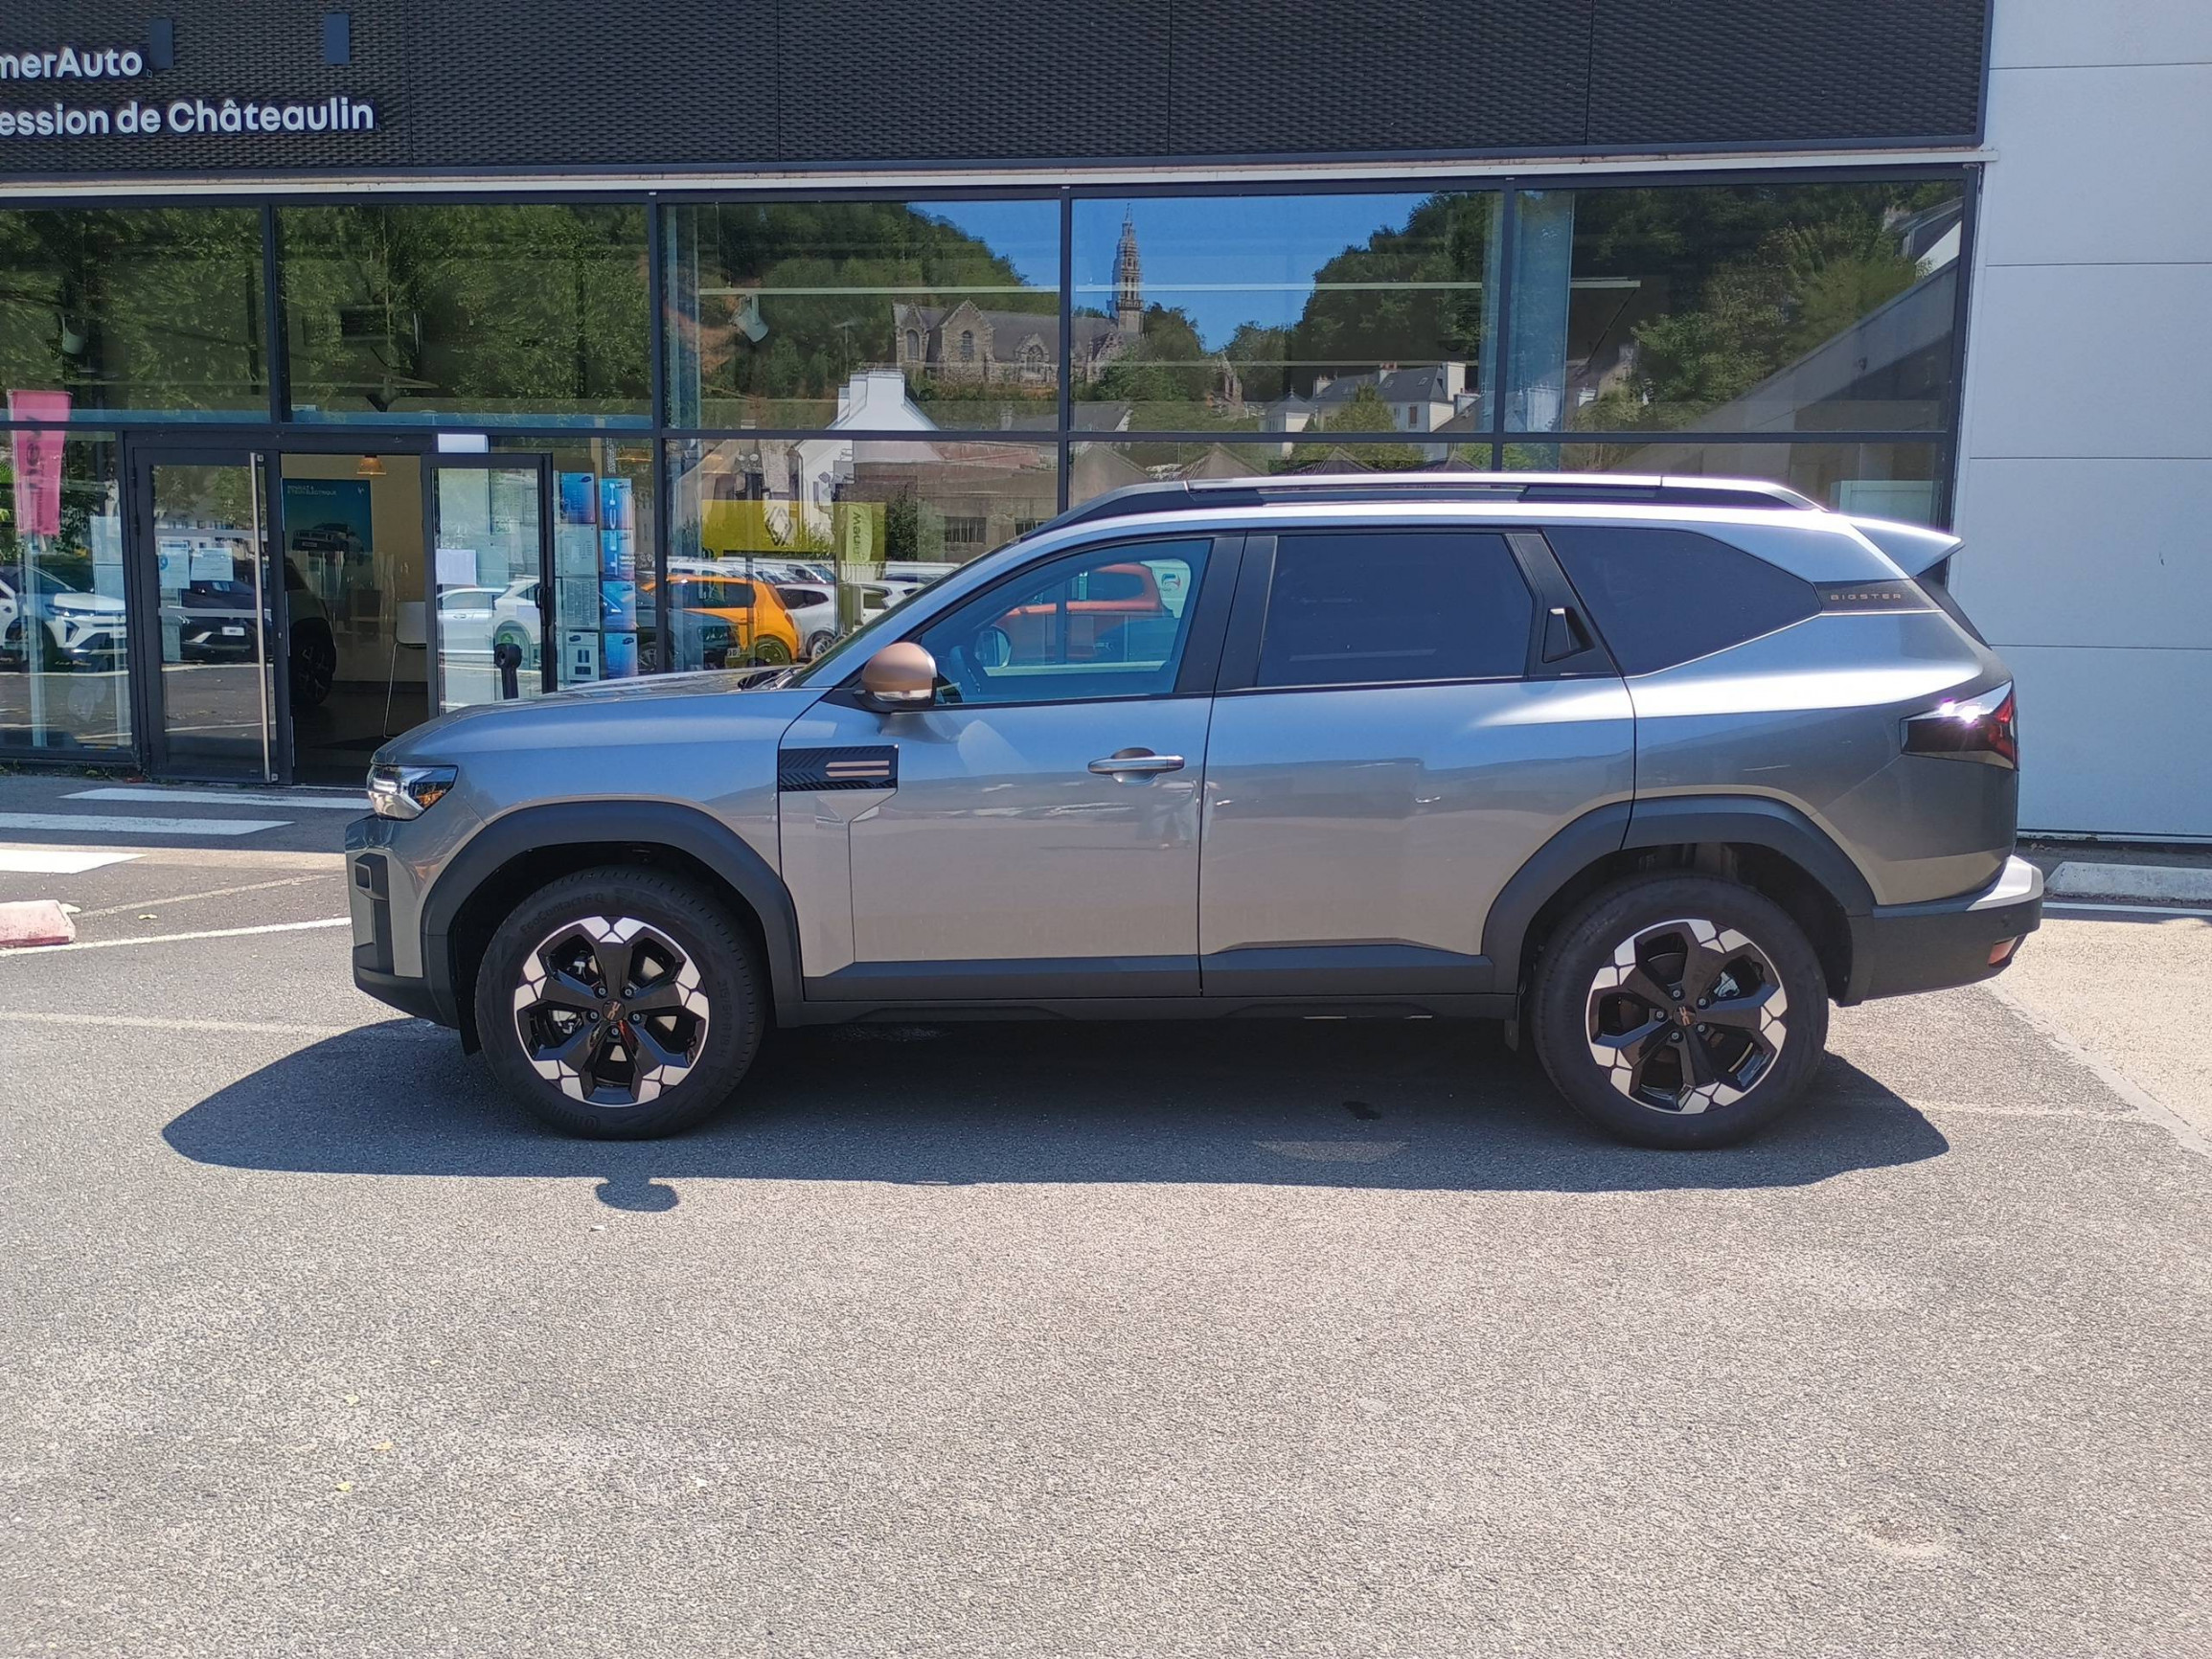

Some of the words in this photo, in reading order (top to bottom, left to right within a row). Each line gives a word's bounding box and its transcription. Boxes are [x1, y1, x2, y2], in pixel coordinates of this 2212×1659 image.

[0, 102, 110, 136] ession
[116, 101, 161, 133] de
[168, 97, 375, 133] Châteaulin
